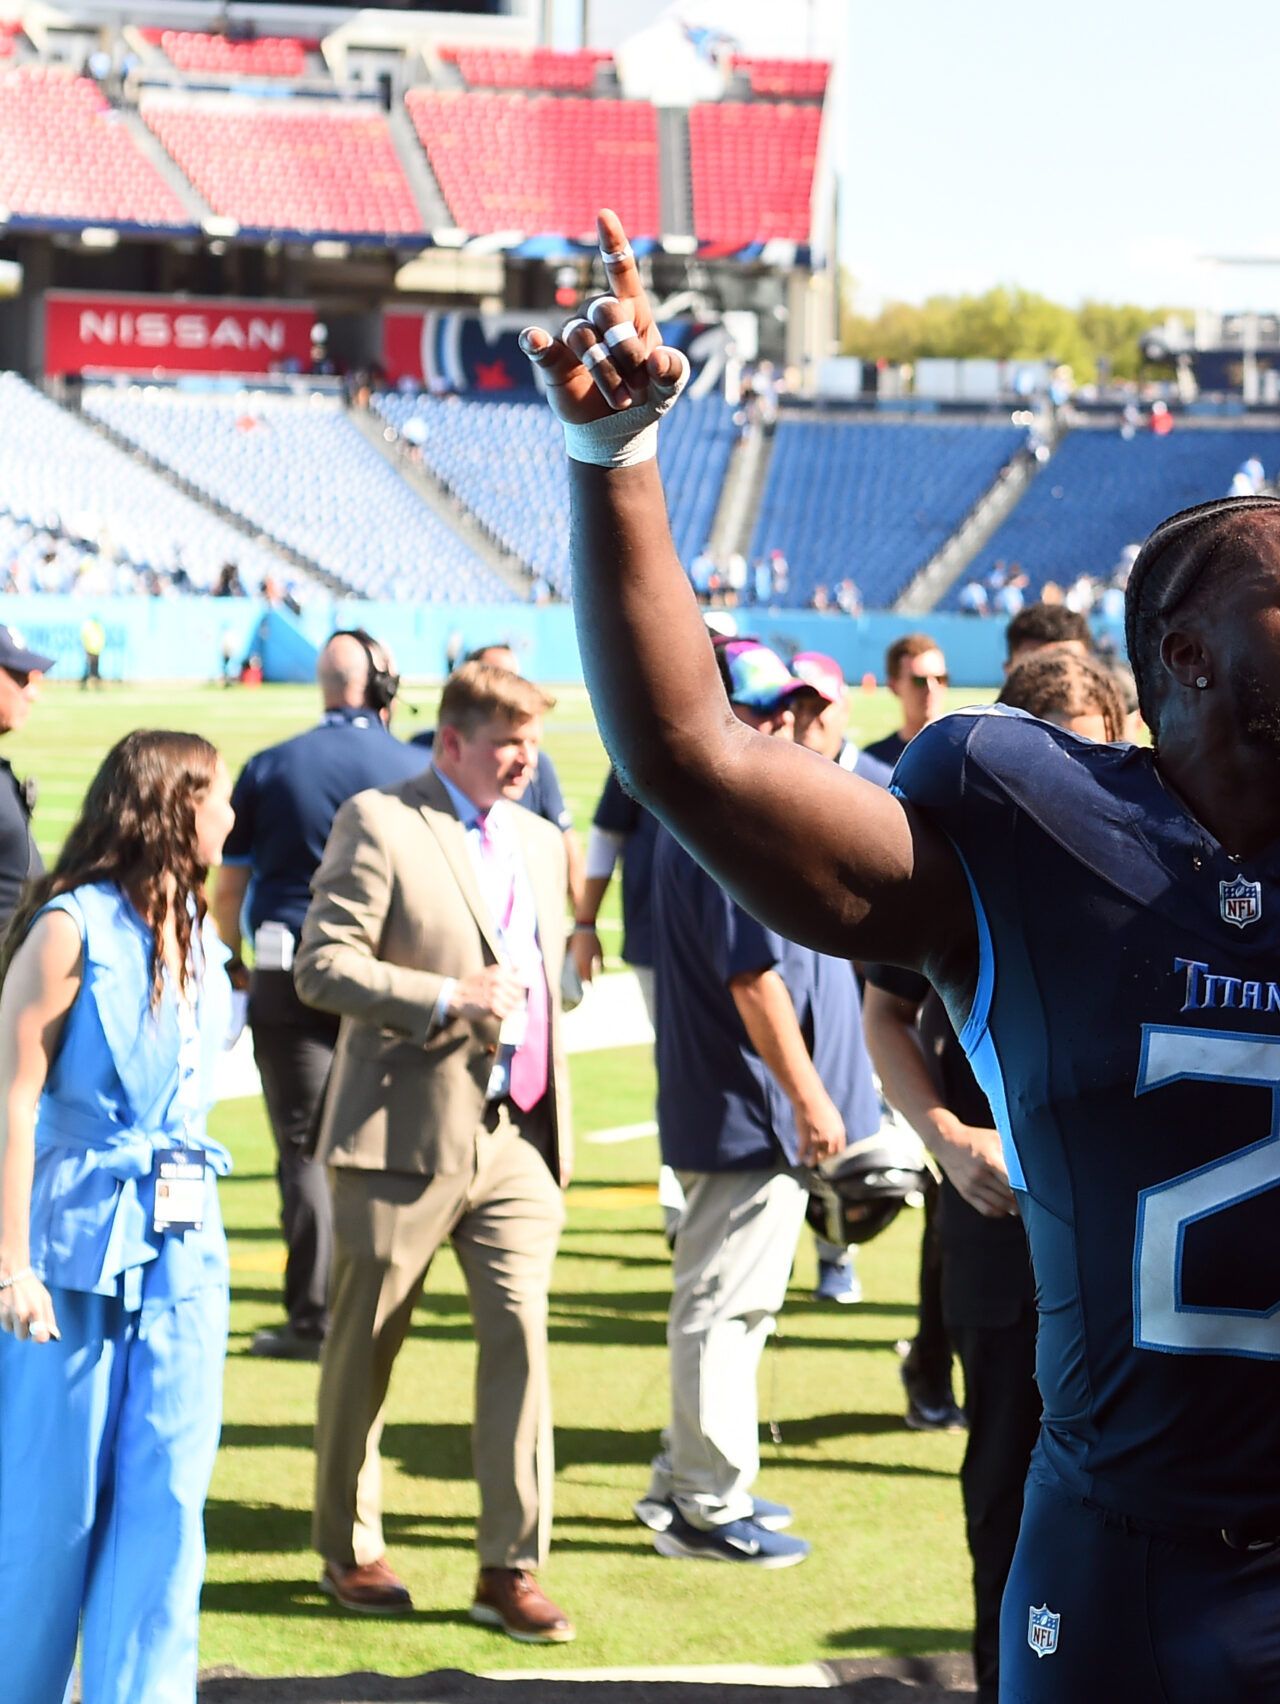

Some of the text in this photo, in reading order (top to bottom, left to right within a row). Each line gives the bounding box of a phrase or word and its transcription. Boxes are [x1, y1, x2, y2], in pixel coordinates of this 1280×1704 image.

[79, 309, 286, 351] NISSAN
[1227, 900, 1255, 919] NFL
[1033, 1627, 1052, 1647] NFL
